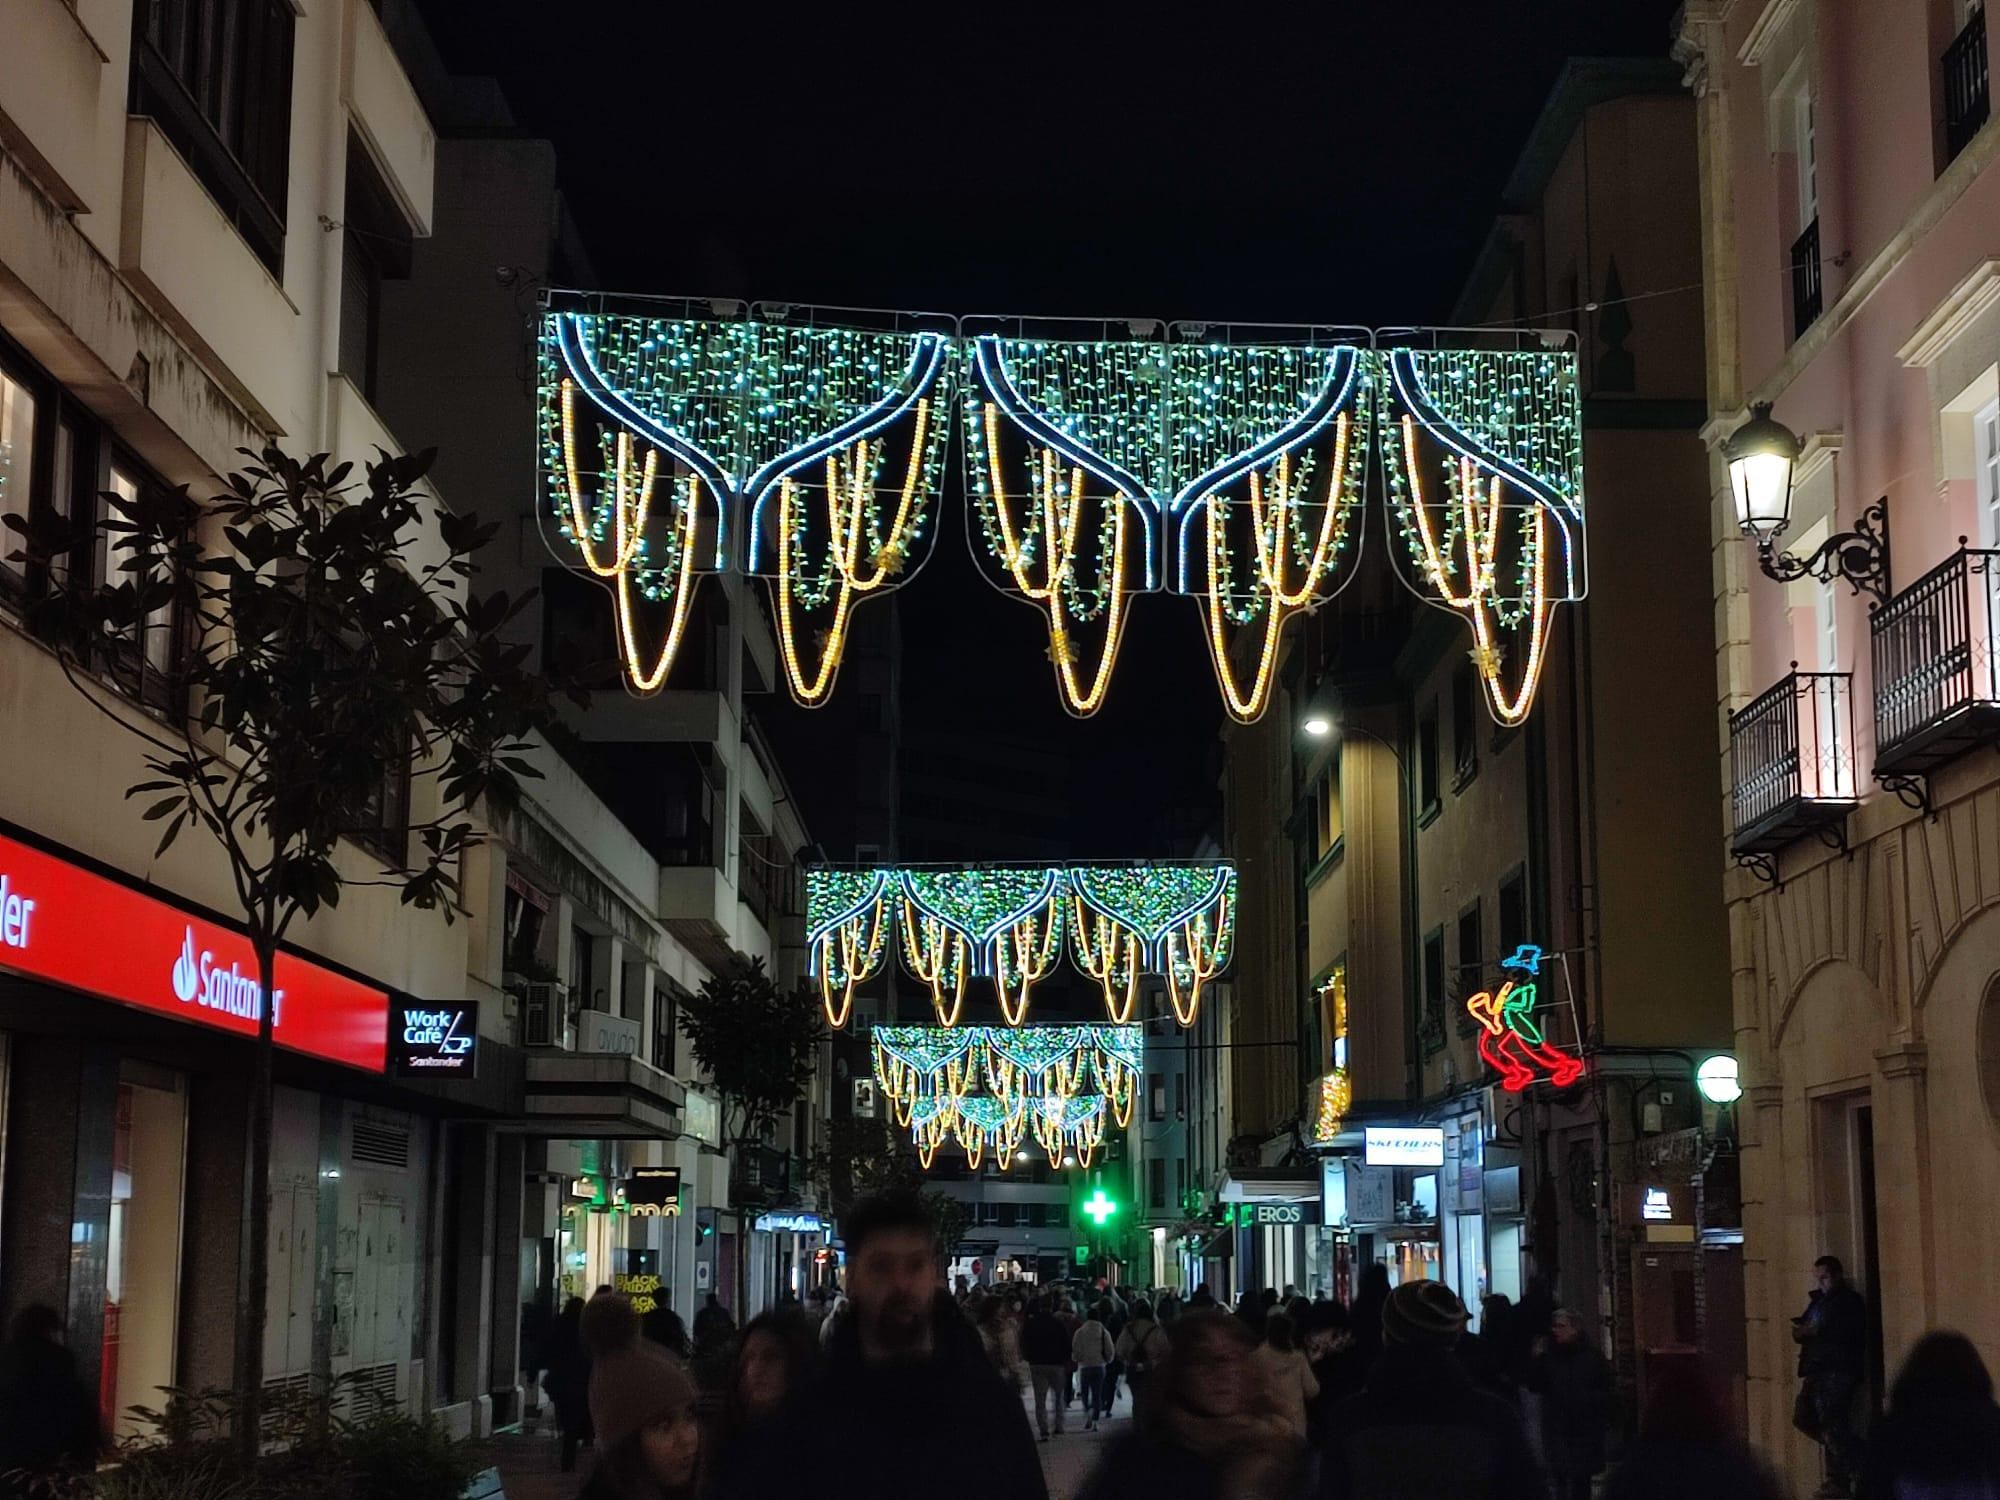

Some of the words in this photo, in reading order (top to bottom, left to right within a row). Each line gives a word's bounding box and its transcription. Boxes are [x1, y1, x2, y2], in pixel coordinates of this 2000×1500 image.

[198, 950, 284, 1027] Santanr
[403, 1010, 451, 1028] Work
[403, 1026, 443, 1044] Café
[409, 1056, 463, 1067] Santander
[1258, 1206, 1301, 1222] EROS
[615, 1274, 659, 1285] BLACK
